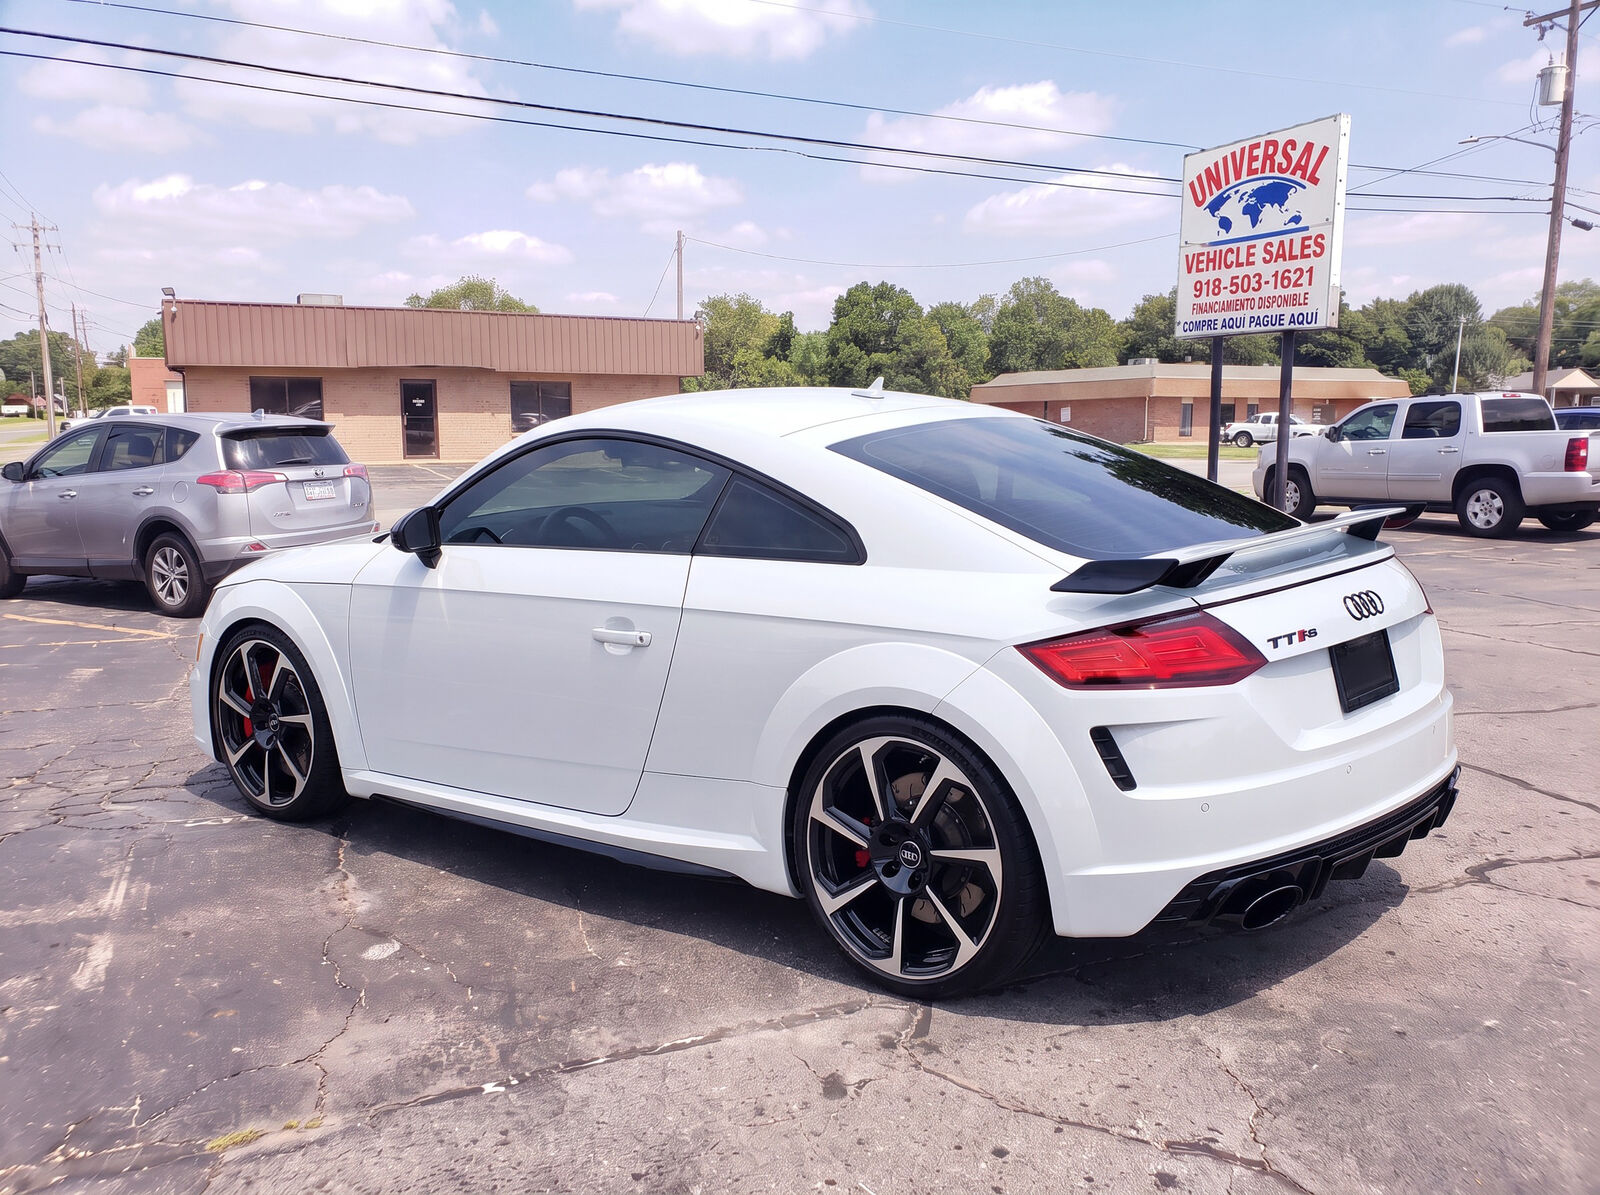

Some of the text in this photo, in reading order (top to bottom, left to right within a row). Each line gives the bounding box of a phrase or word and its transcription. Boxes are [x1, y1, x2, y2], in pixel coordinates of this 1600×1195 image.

[1188, 139, 1330, 208] UNIVERSAL
[1184, 233, 1326, 274] VEHICLE SALES
[1193, 266, 1314, 299] 918-503-1621
[1191, 292, 1309, 315] FINANCIAMIENTO DISPONIBLE
[1182, 308, 1319, 333] COMPRE AQUÍ PAGUE AQUÍ
